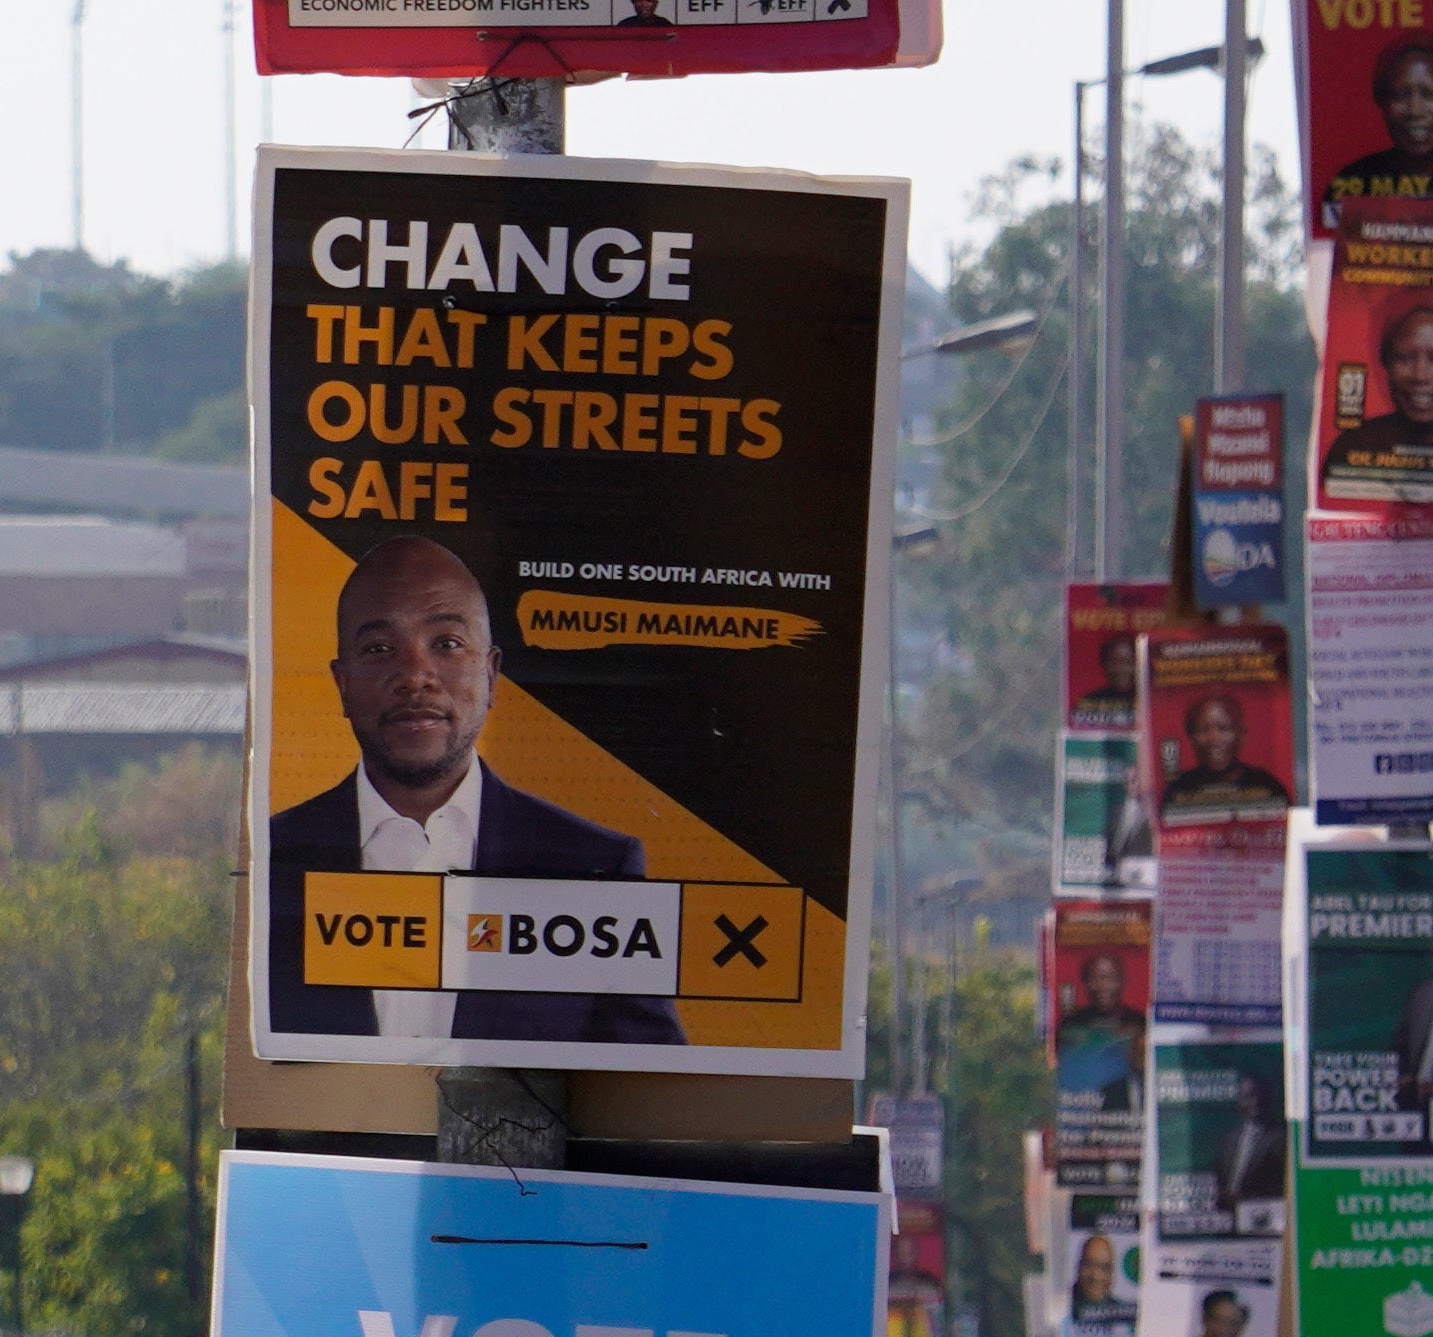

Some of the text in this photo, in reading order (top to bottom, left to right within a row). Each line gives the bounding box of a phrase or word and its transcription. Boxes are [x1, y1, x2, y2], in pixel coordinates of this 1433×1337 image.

[300, 0, 591, 11] ECONOMIC FREEDOM FIGHTERS
[688, 0, 724, 12] EFF
[777, 0, 807, 10] EFF
[1317, 0, 1424, 30] VOTE
[1370, 174, 1430, 198] MAY
[311, 216, 694, 300] CHANGE
[307, 304, 735, 380] THAT KEEPS
[307, 380, 784, 460] OUR STREETS
[308, 456, 469, 522] SAFE
[519, 560, 832, 591] BUILD ONE SOUTH AFRICA WITH
[530, 608, 780, 640] MMUSI MAIMANE
[314, 912, 428, 949] VOTE
[508, 913, 664, 960] BOSA
[1314, 1069, 1400, 1088] POWER
[1314, 1088, 1400, 1112] BACK
